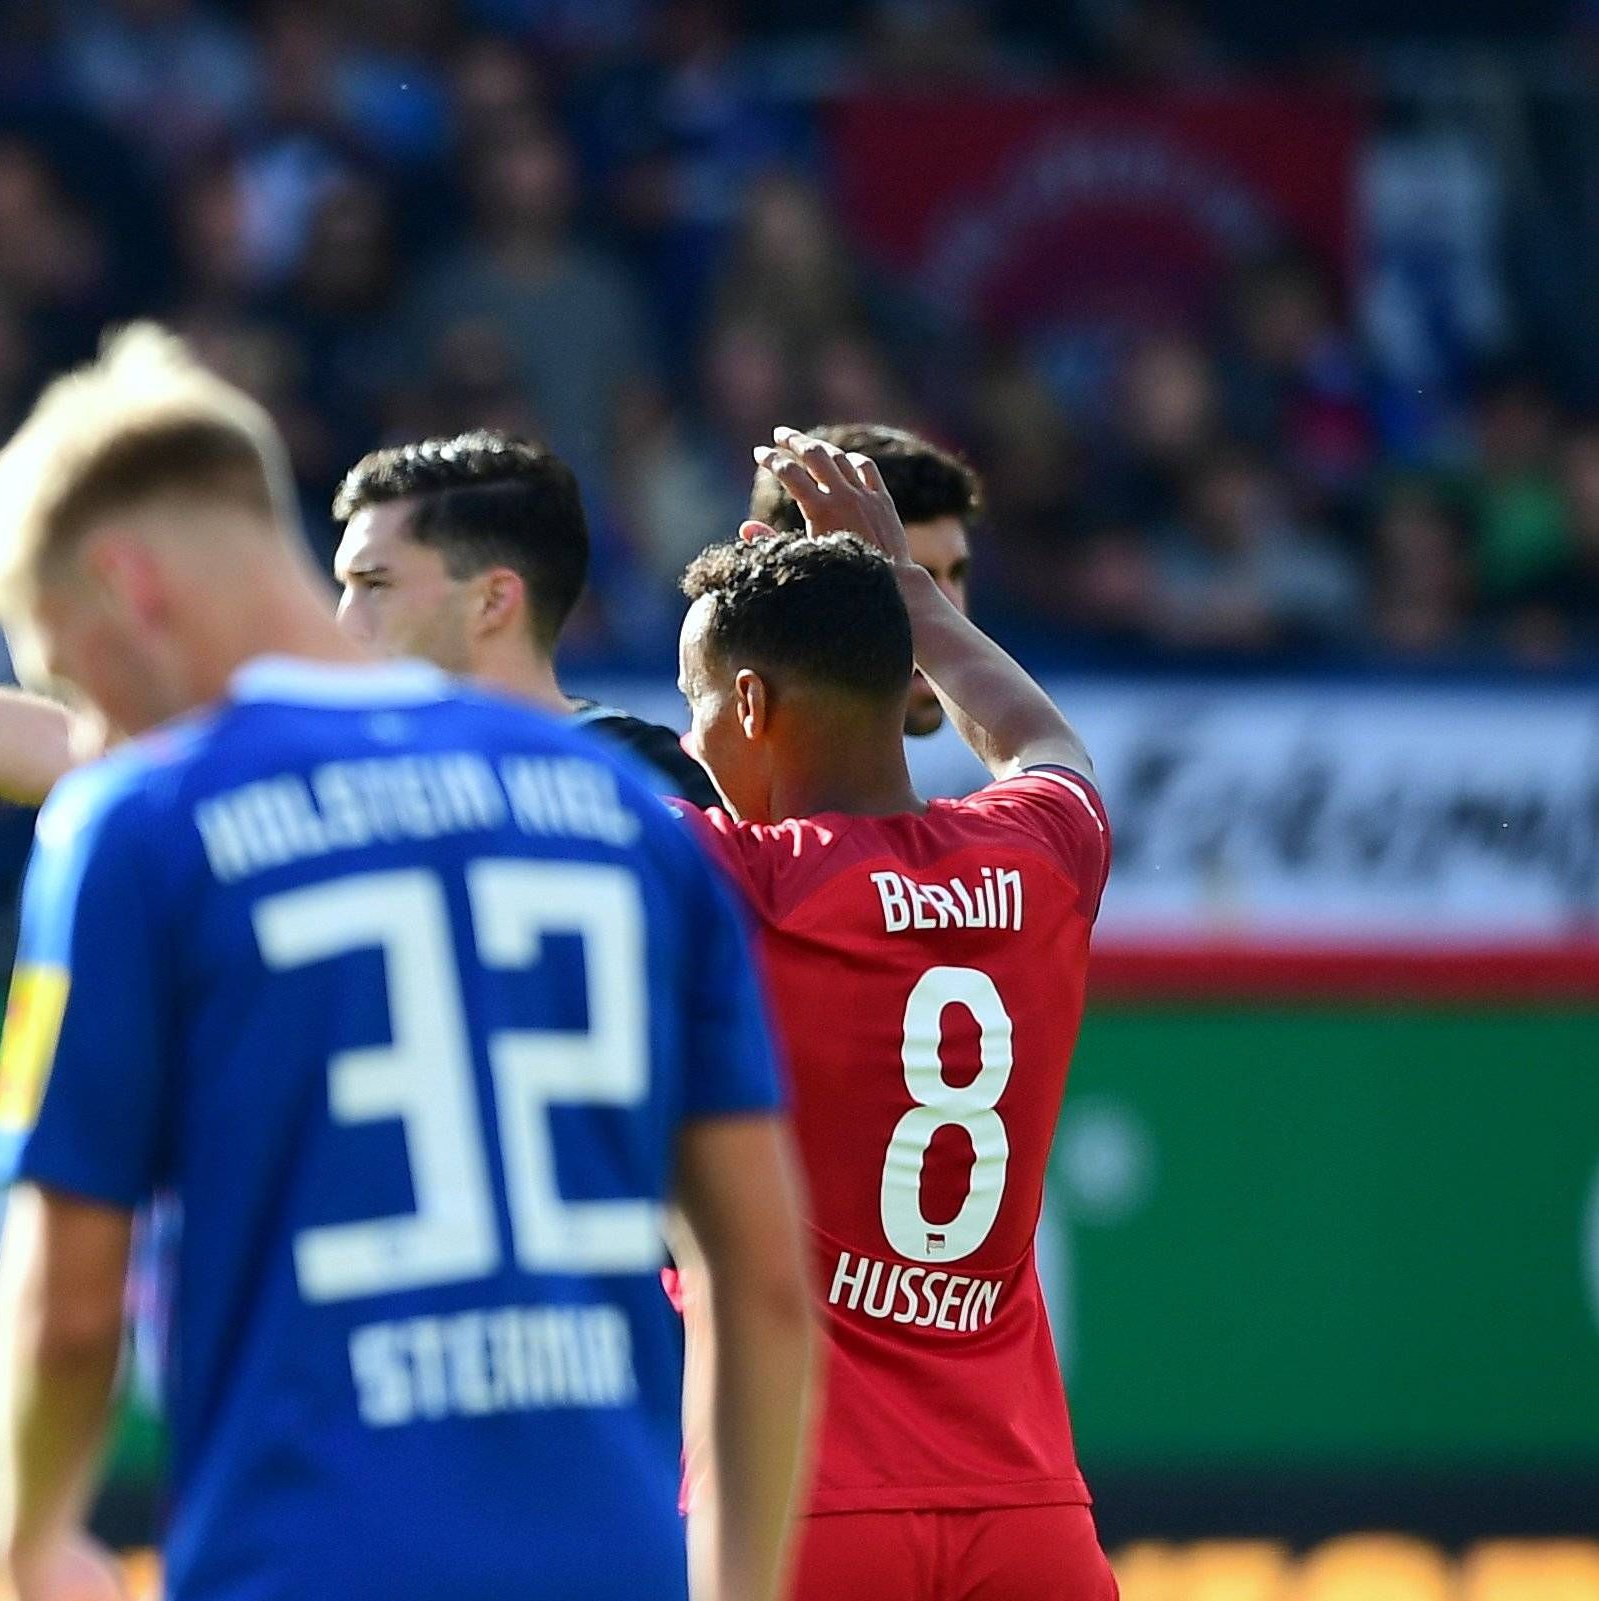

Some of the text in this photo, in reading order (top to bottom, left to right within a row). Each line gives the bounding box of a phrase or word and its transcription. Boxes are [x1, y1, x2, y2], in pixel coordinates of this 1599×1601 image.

[250, 855, 667, 1306] 32
[880, 966, 1014, 1263] 8
[828, 1251, 1003, 1333] HUSSEIN
